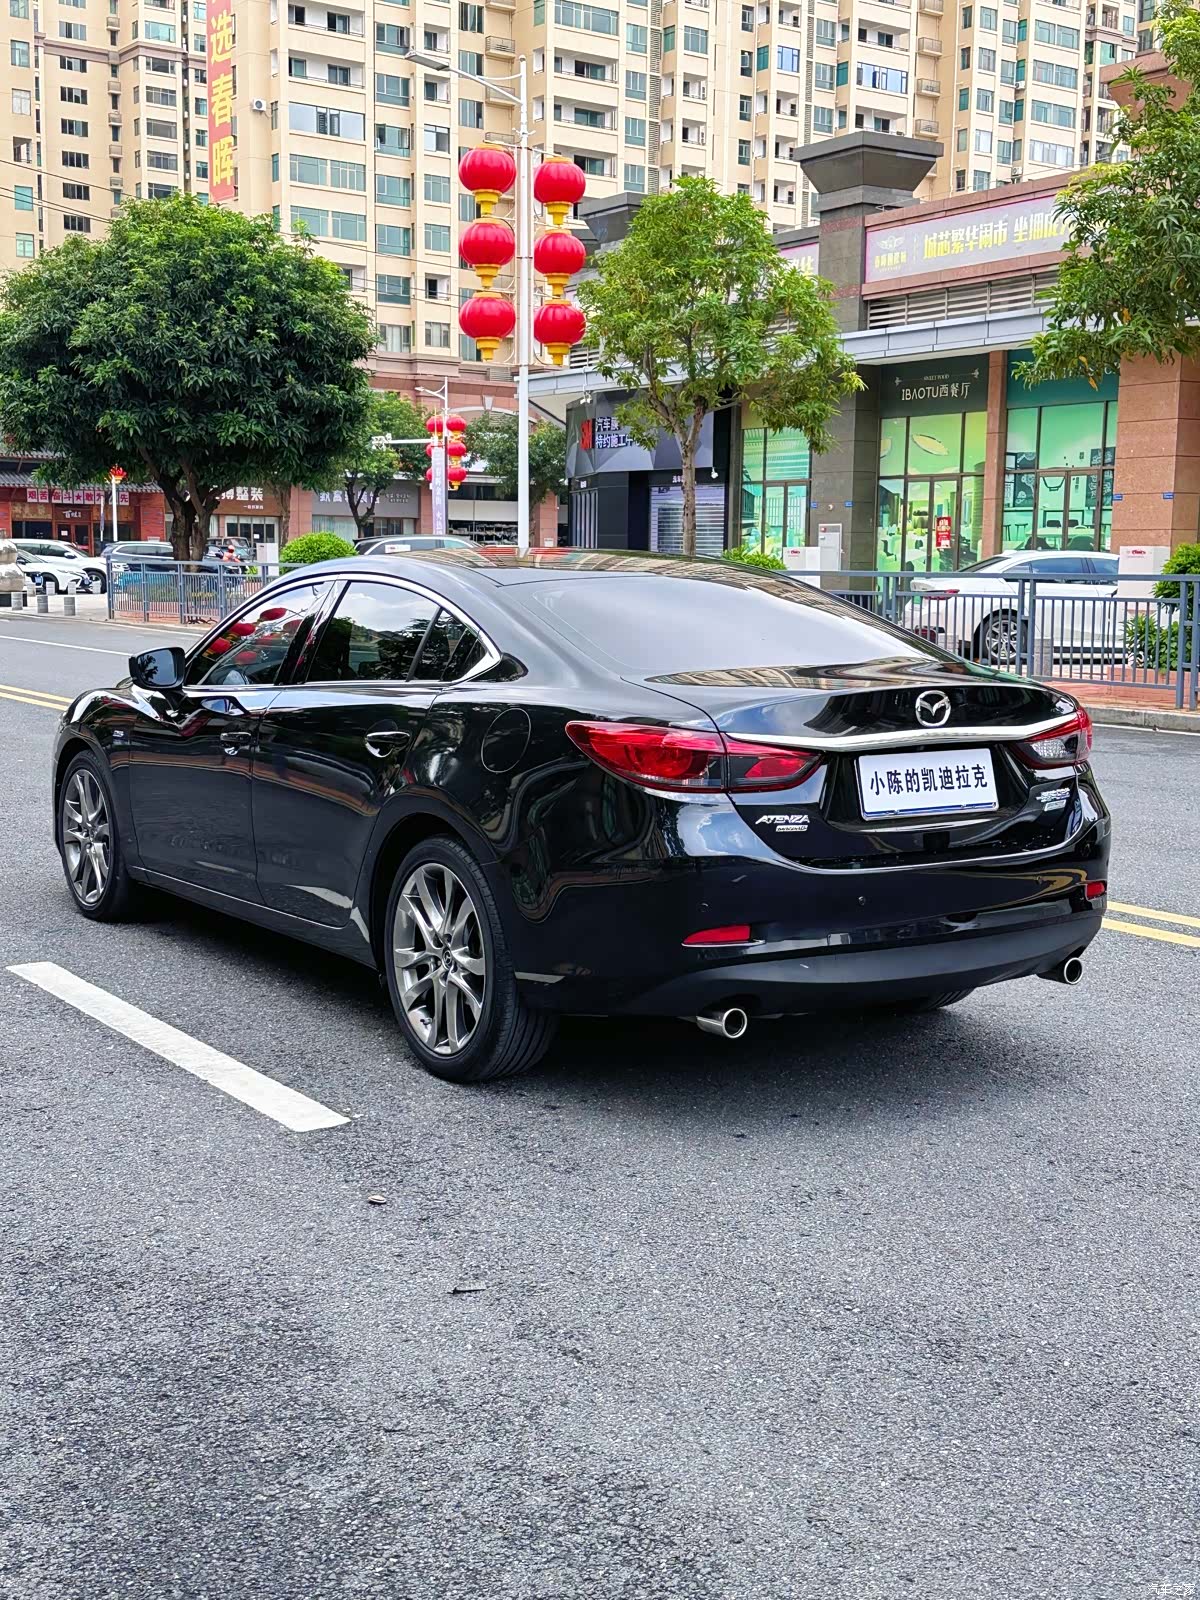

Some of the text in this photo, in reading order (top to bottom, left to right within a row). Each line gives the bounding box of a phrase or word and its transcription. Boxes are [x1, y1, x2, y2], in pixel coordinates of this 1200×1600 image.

[210, 0, 234, 187] 选春晖
[595, 434, 641, 450] 特约施工中
[28, 490, 129, 503] 艰苦奋斗 敢为先
[870, 763, 988, 796] 小陈的凯迪拉克
[755, 814, 811, 825] ATENZA
